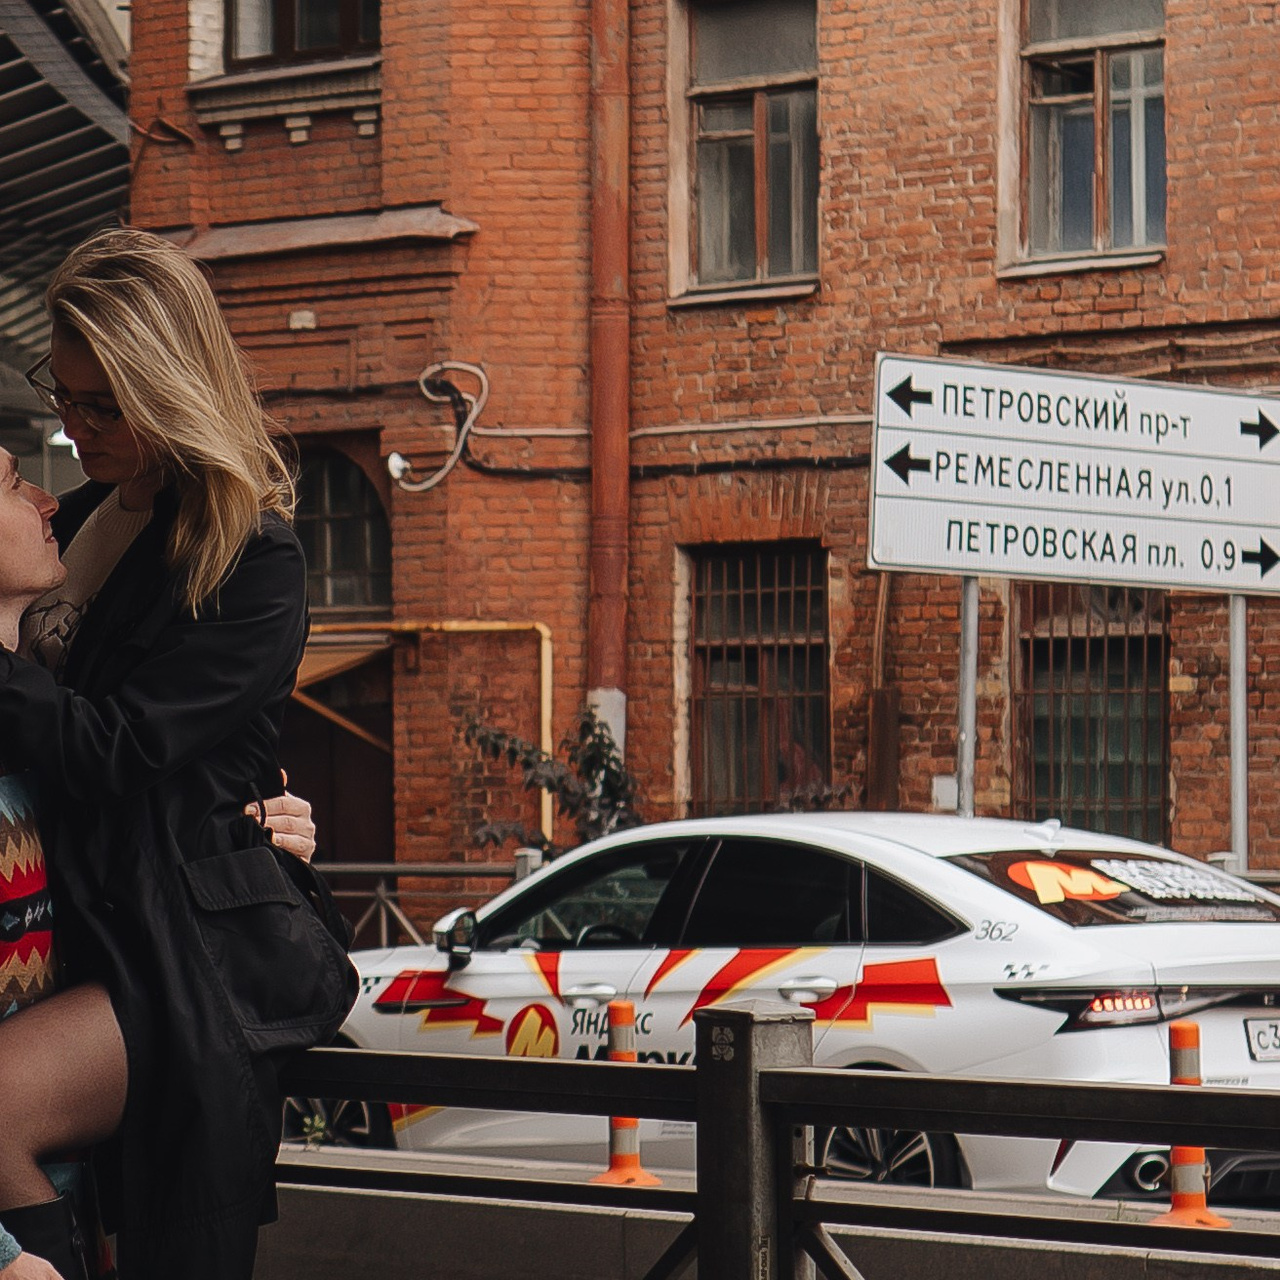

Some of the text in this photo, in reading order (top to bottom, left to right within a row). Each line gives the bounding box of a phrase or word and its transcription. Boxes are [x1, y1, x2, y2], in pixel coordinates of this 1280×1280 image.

[943, 383, 1191, 444] ПЕТРОВСКИЙ пр-т
[935, 451, 1152, 500] РЕМЕСЛЕННАЯ
[947, 520, 1236, 572] ПЕТРОВСКАЯ пл. 0,9
[975, 919, 1019, 941] 362
